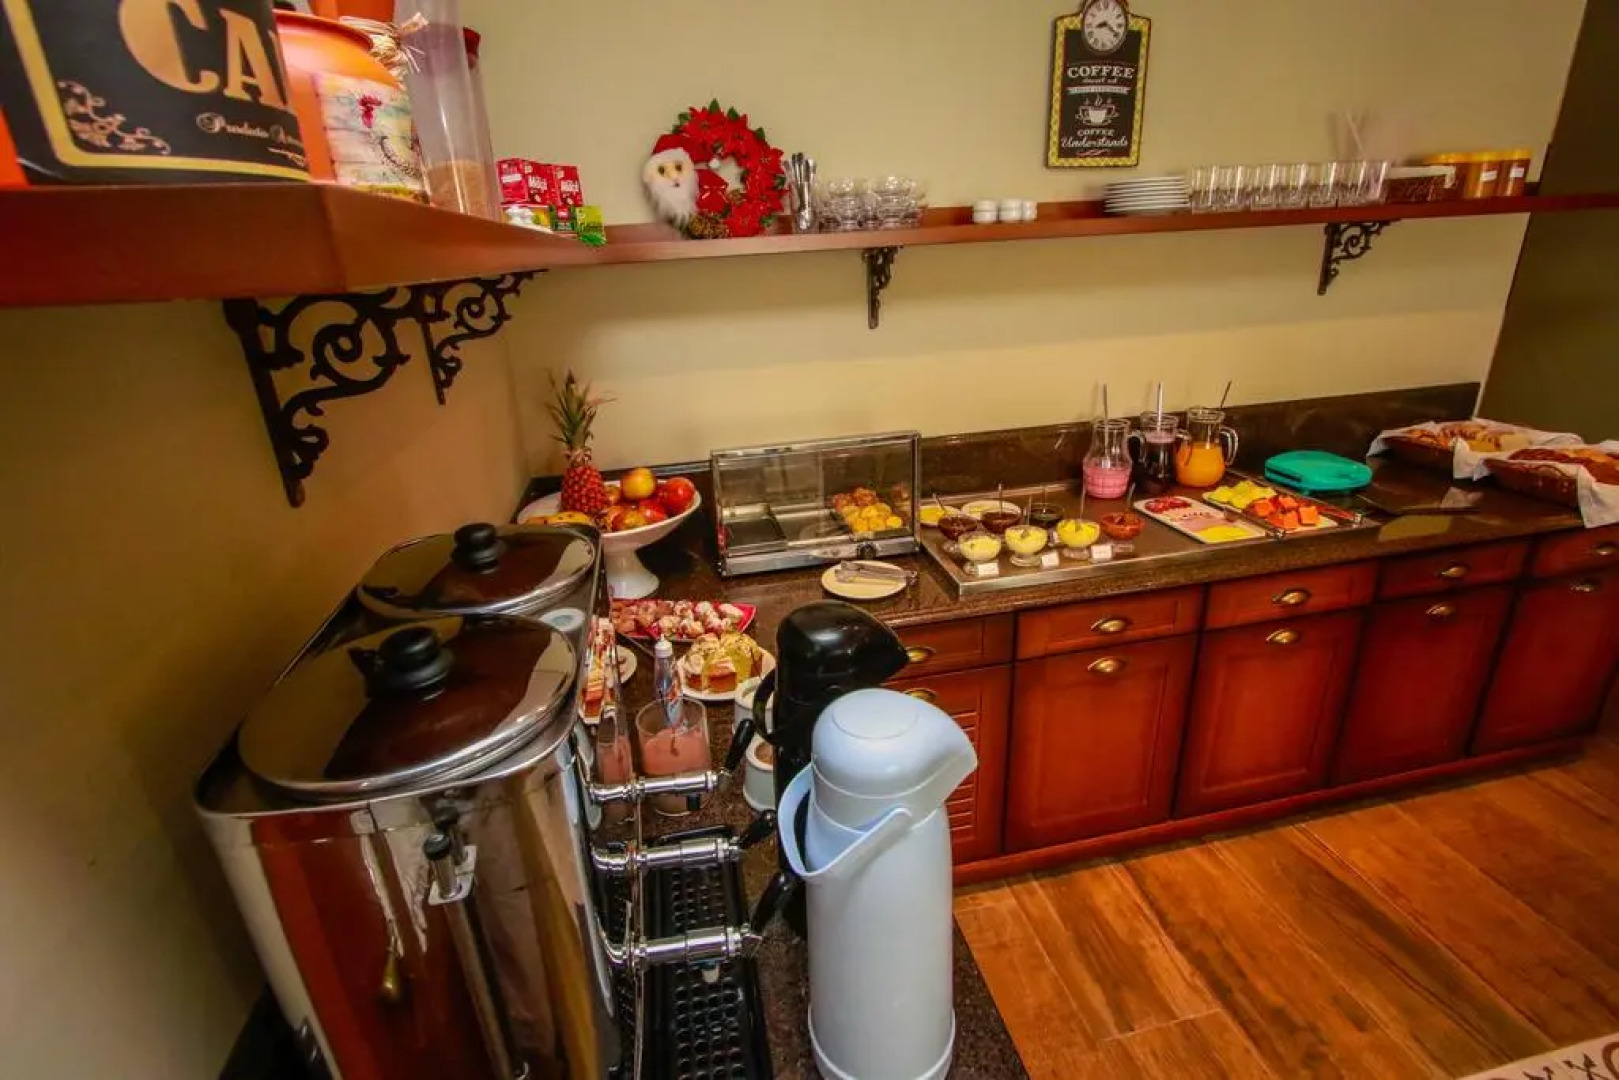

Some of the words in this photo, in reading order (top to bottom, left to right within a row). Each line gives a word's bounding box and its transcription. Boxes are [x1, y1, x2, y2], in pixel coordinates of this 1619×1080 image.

[118, 0, 291, 112] CA
[1067, 65, 1135, 79] COFFEE
[1077, 129, 1115, 137] COFFEE
